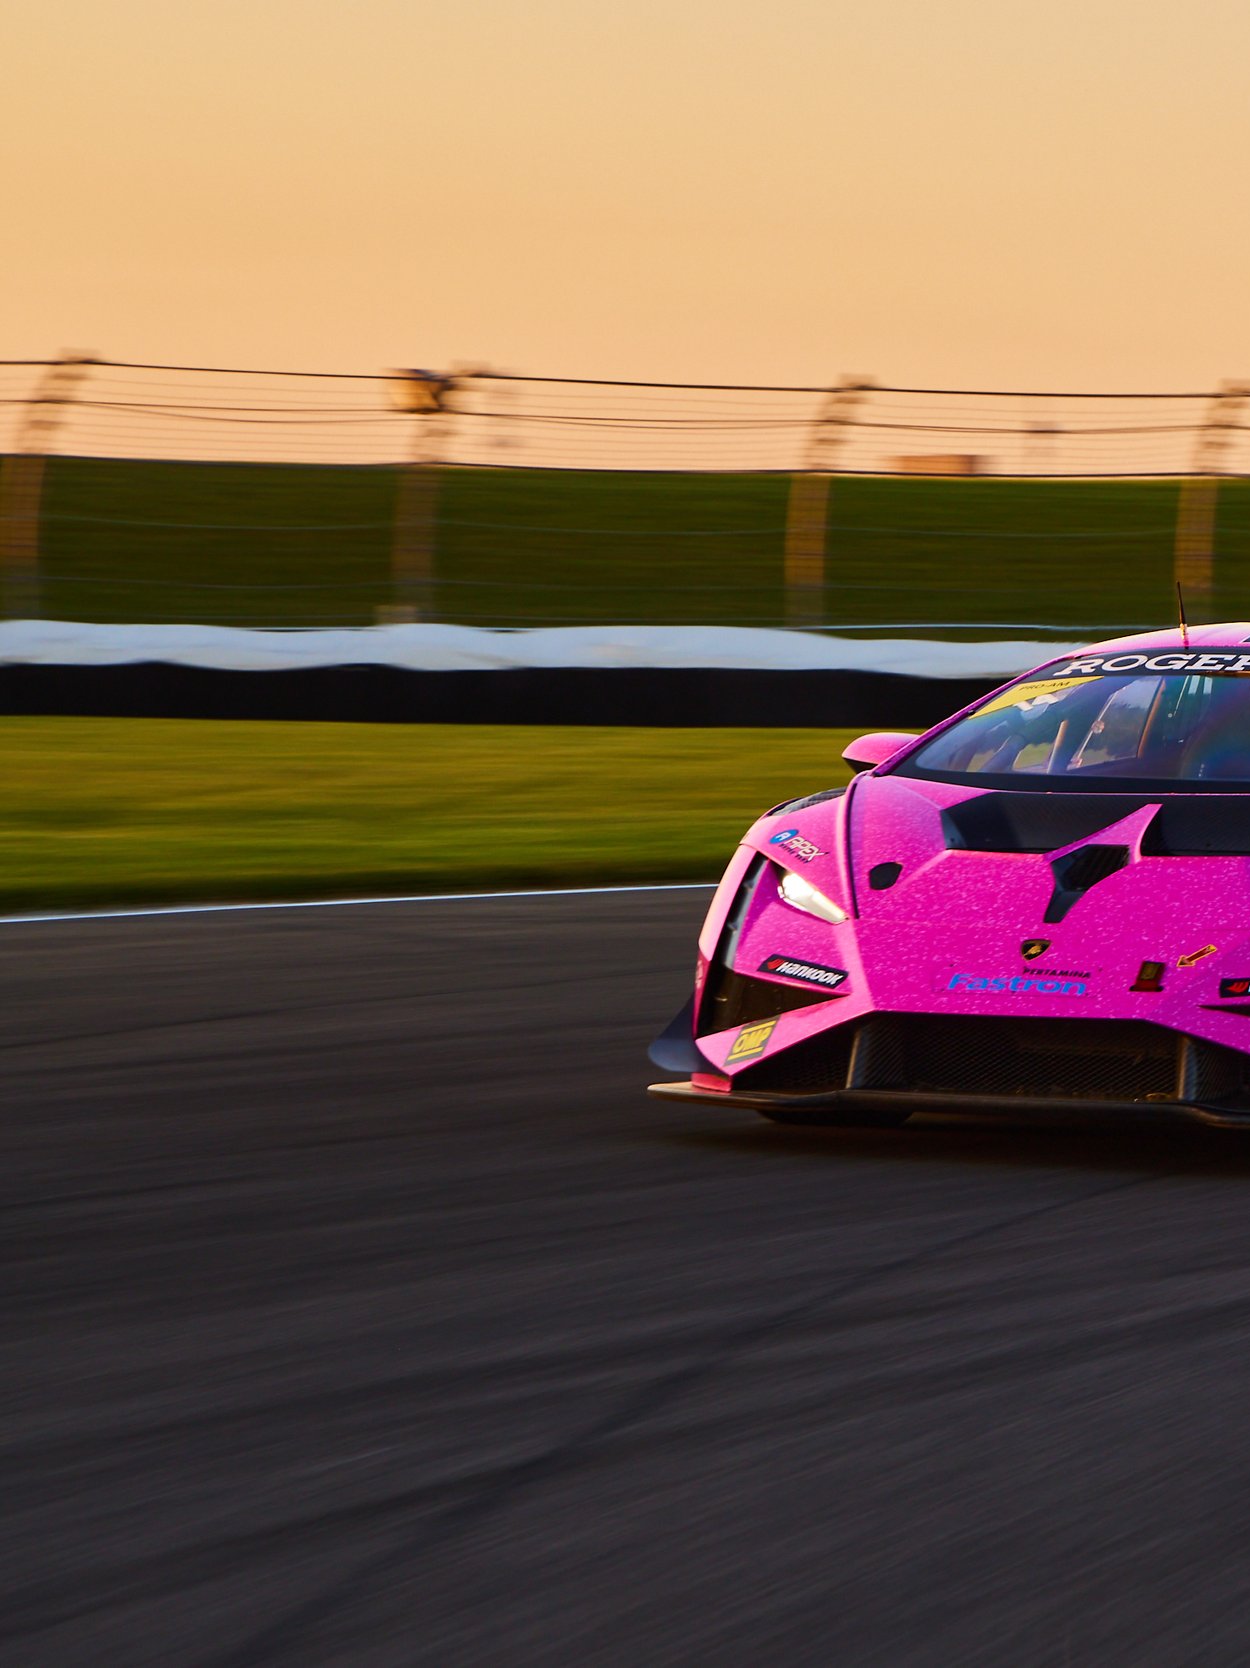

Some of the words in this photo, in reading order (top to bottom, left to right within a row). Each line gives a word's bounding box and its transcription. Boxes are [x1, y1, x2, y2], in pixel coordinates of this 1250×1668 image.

[783, 836, 826, 862] APEX
[1022, 966, 1092, 979] PERTAMINA
[948, 974, 1087, 996] Fastron
[732, 1027, 772, 1054] OMP
